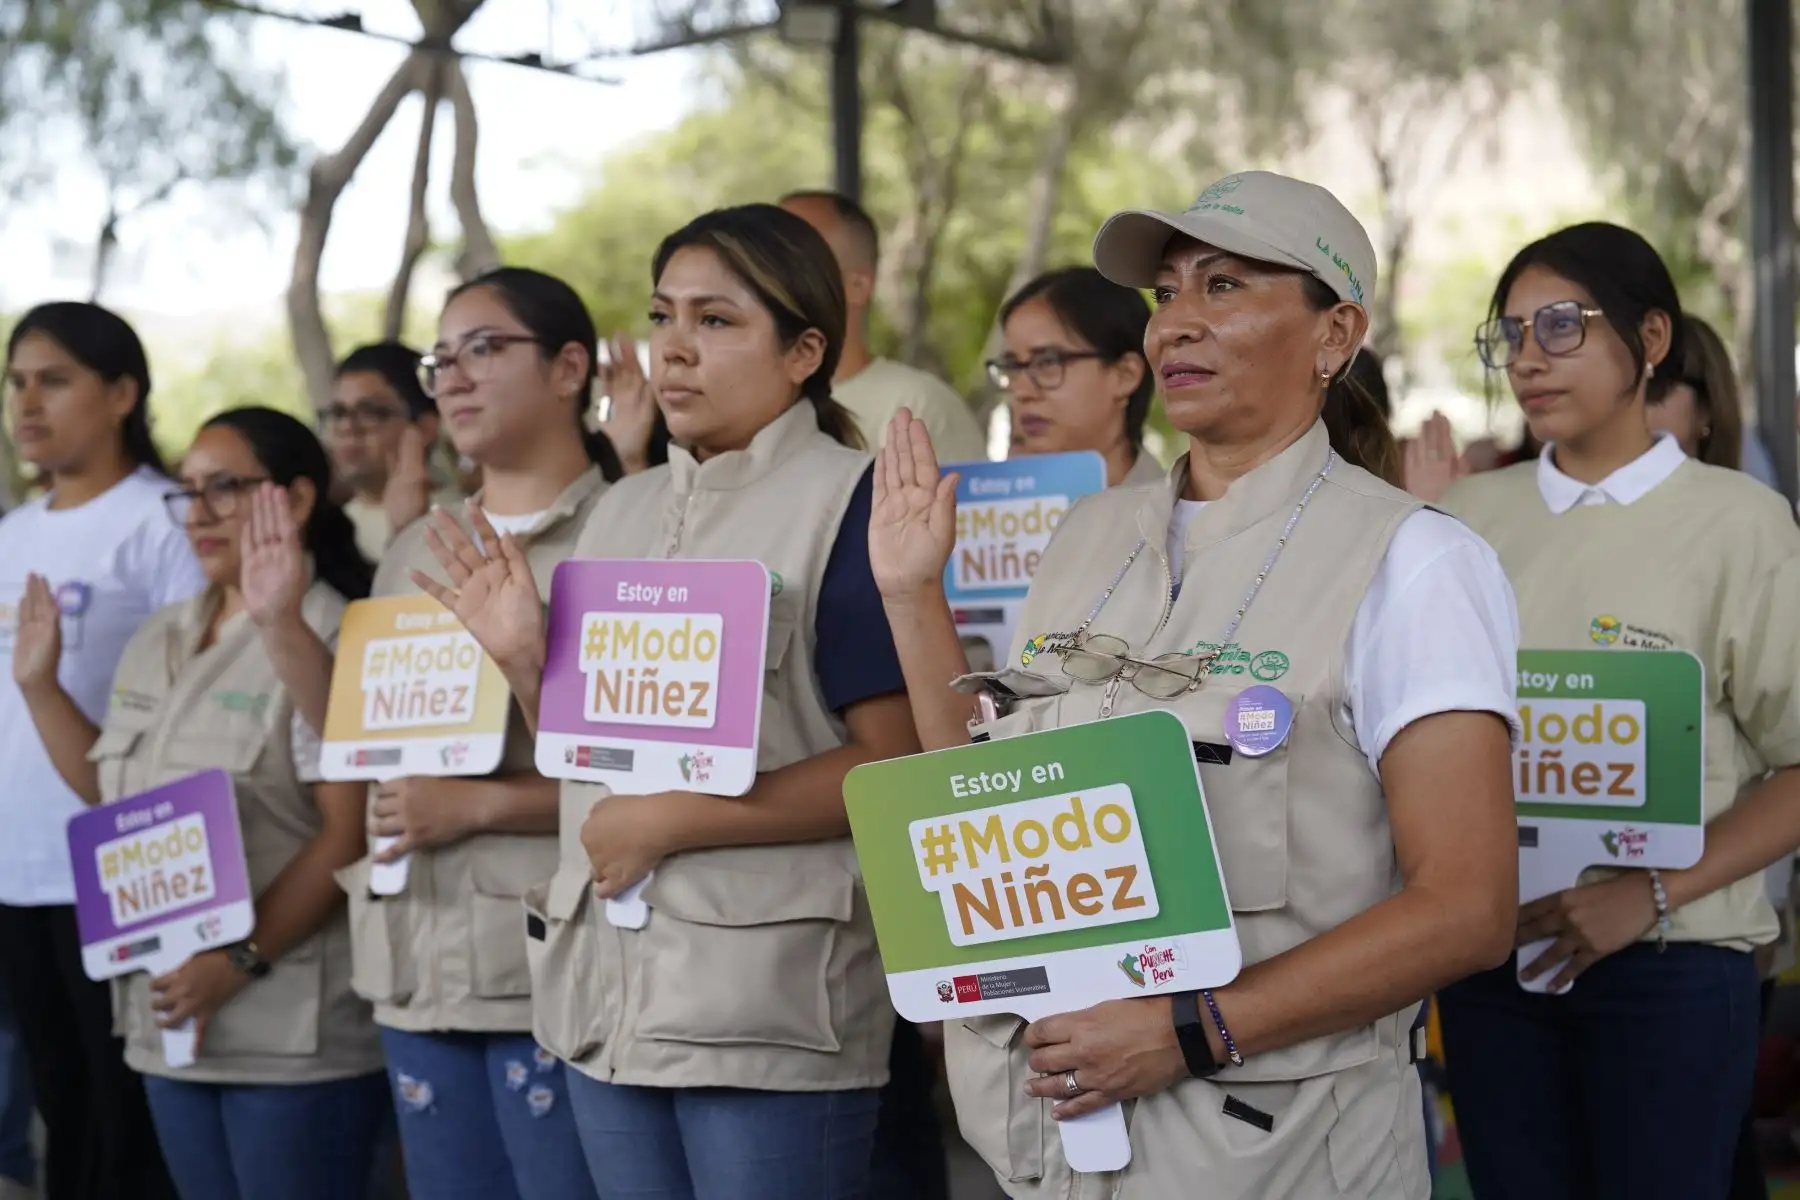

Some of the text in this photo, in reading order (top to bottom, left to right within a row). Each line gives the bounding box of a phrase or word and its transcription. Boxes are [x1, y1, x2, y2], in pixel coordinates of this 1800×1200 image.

[1316, 236, 1329, 255] LA
[969, 476, 1035, 495] Estoy en
[962, 542, 1042, 583] Niñe
[617, 581, 688, 606] Estoy en
[368, 637, 476, 678] #Modo
[585, 617, 717, 663] #Modo
[372, 679, 470, 722] Niñez
[594, 667, 710, 717] Niñez
[1517, 671, 1594, 693] toy en
[950, 761, 1065, 798] Estoy en
[1520, 749, 1636, 796] iñez
[103, 823, 203, 879] #Modo
[920, 797, 1132, 877] #Modo
[116, 864, 208, 919] Niñez
[952, 864, 1146, 936] Niñez
[1145, 944, 1157, 953] Con
[957, 982, 977, 994] PERÚ
[983, 984, 1047, 997] Poblaciones Vulnerables
[995, 981, 1012, 989] Mujer
[1152, 968, 1175, 984] Perú
